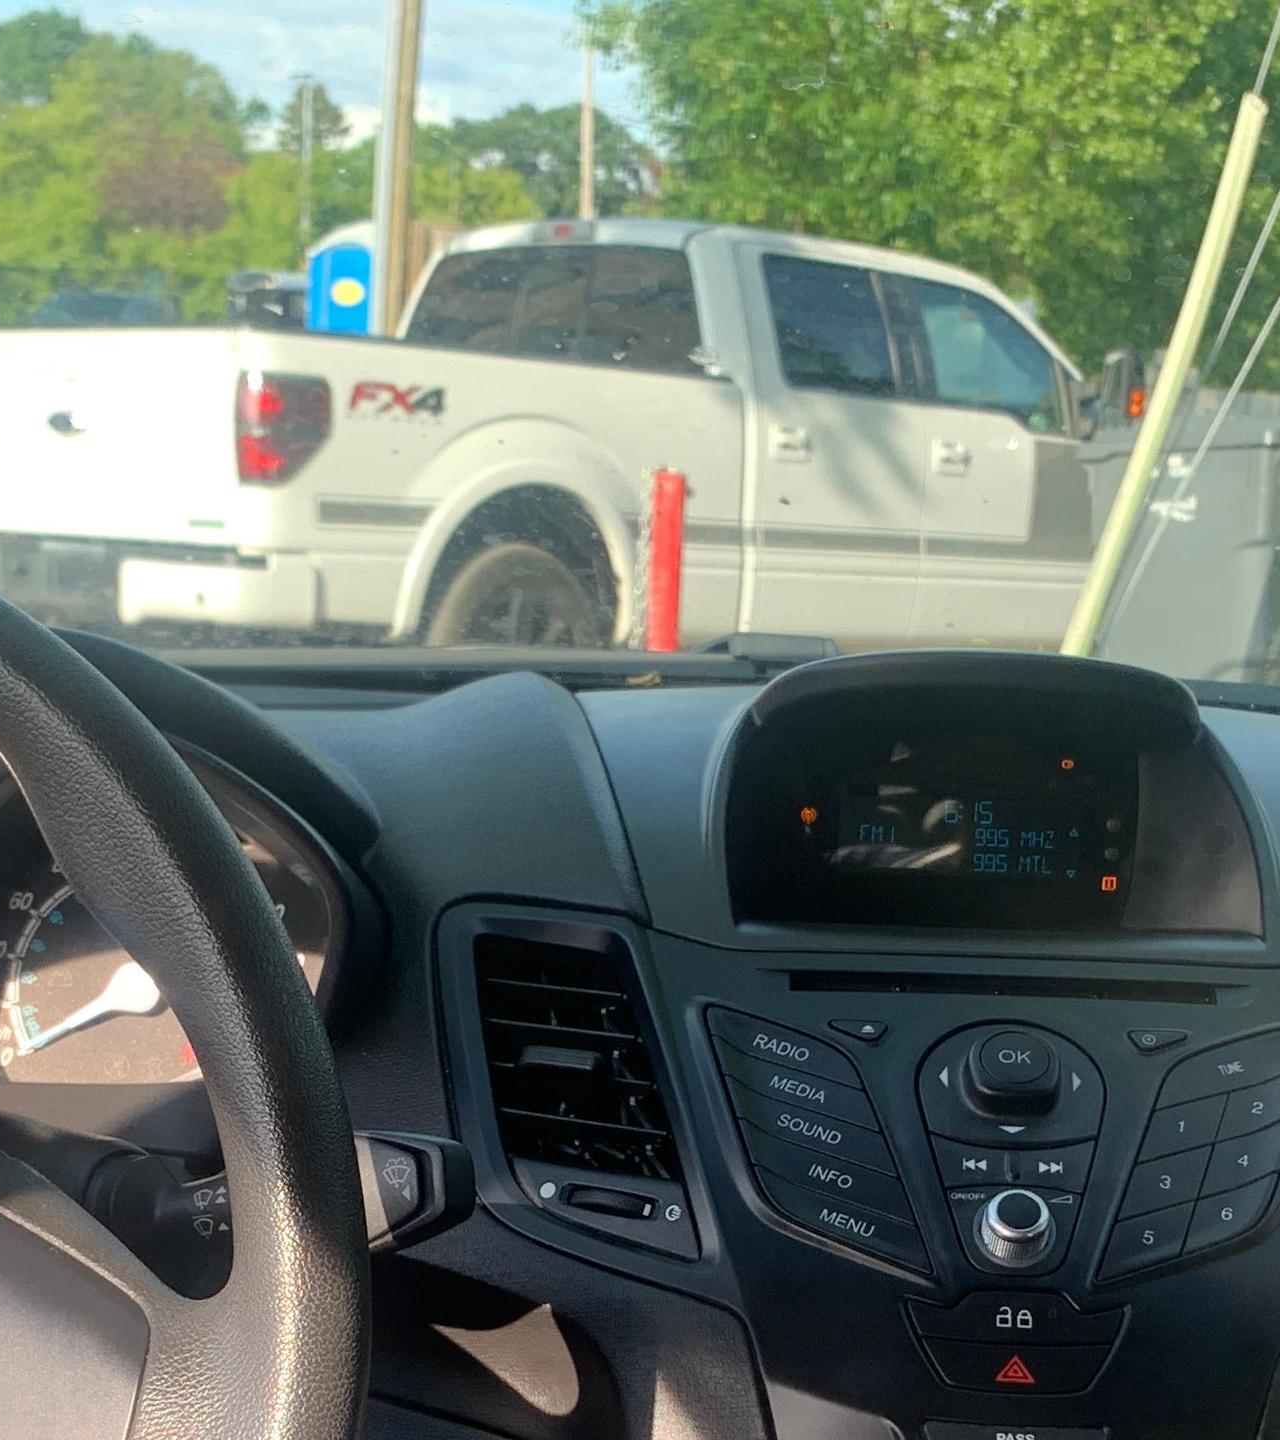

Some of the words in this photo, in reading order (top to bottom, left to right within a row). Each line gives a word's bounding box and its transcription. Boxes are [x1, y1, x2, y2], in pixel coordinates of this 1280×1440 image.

[348, 381, 445, 418] FX4
[8, 891, 34, 911] 60
[752, 1033, 810, 1062] RADIO
[998, 1050, 1032, 1065] OK
[1216, 1060, 1245, 1075] TUNE
[770, 1075, 826, 1104] MEDIA
[1252, 1101, 1264, 1115] 2
[777, 1113, 842, 1145] SOUND
[1178, 1120, 1186, 1133] 1
[1237, 1154, 1249, 1168] 4
[808, 1163, 853, 1189] INFO
[1159, 1175, 1172, 1190] 3
[950, 1192, 986, 1201] ON/OFF
[1220, 1207, 1233, 1221] 6
[819, 1207, 876, 1238] MENU
[1142, 1230, 1155, 1245] 5
